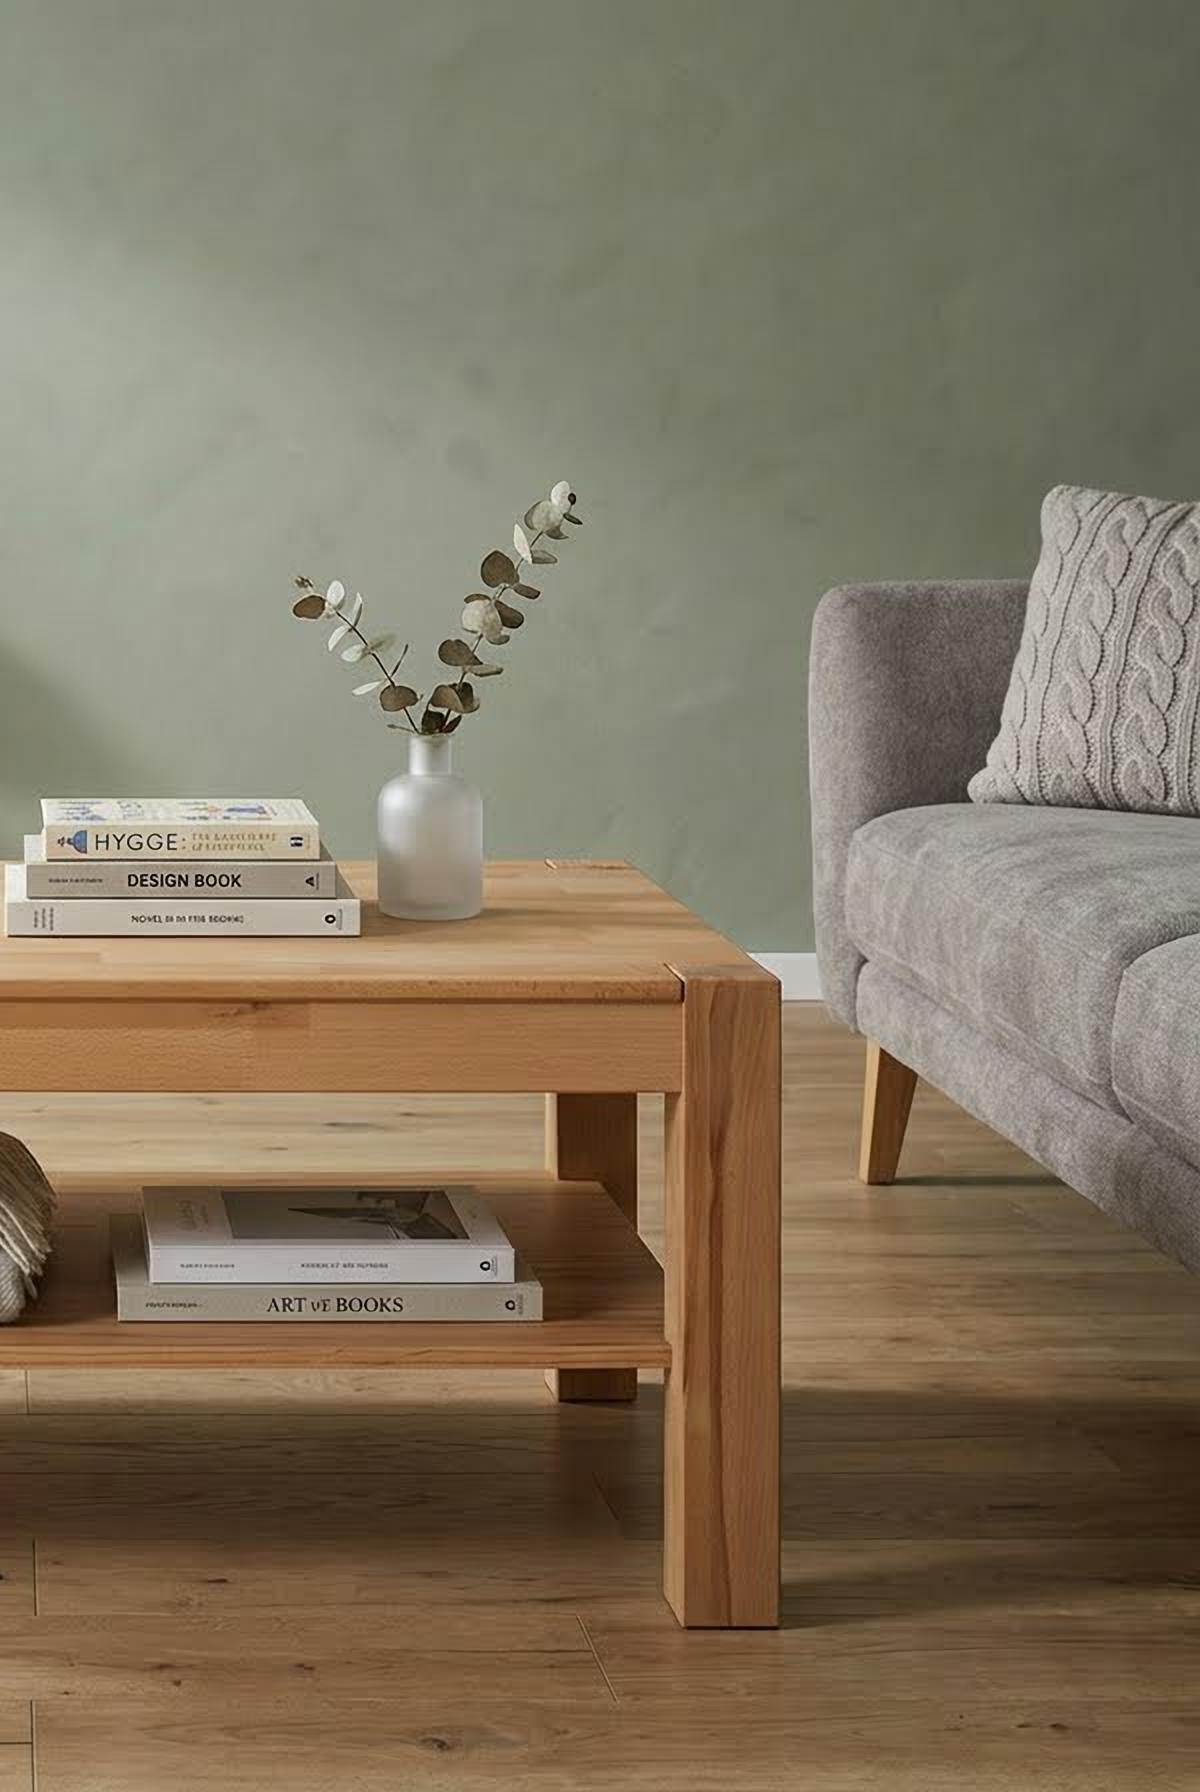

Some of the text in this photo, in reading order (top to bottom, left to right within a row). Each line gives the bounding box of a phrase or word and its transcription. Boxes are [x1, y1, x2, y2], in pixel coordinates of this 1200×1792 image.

[127, 873, 242, 888] DESIGN BOOK
[266, 1297, 307, 1313] ART
[336, 1297, 404, 1313] BOOKS
